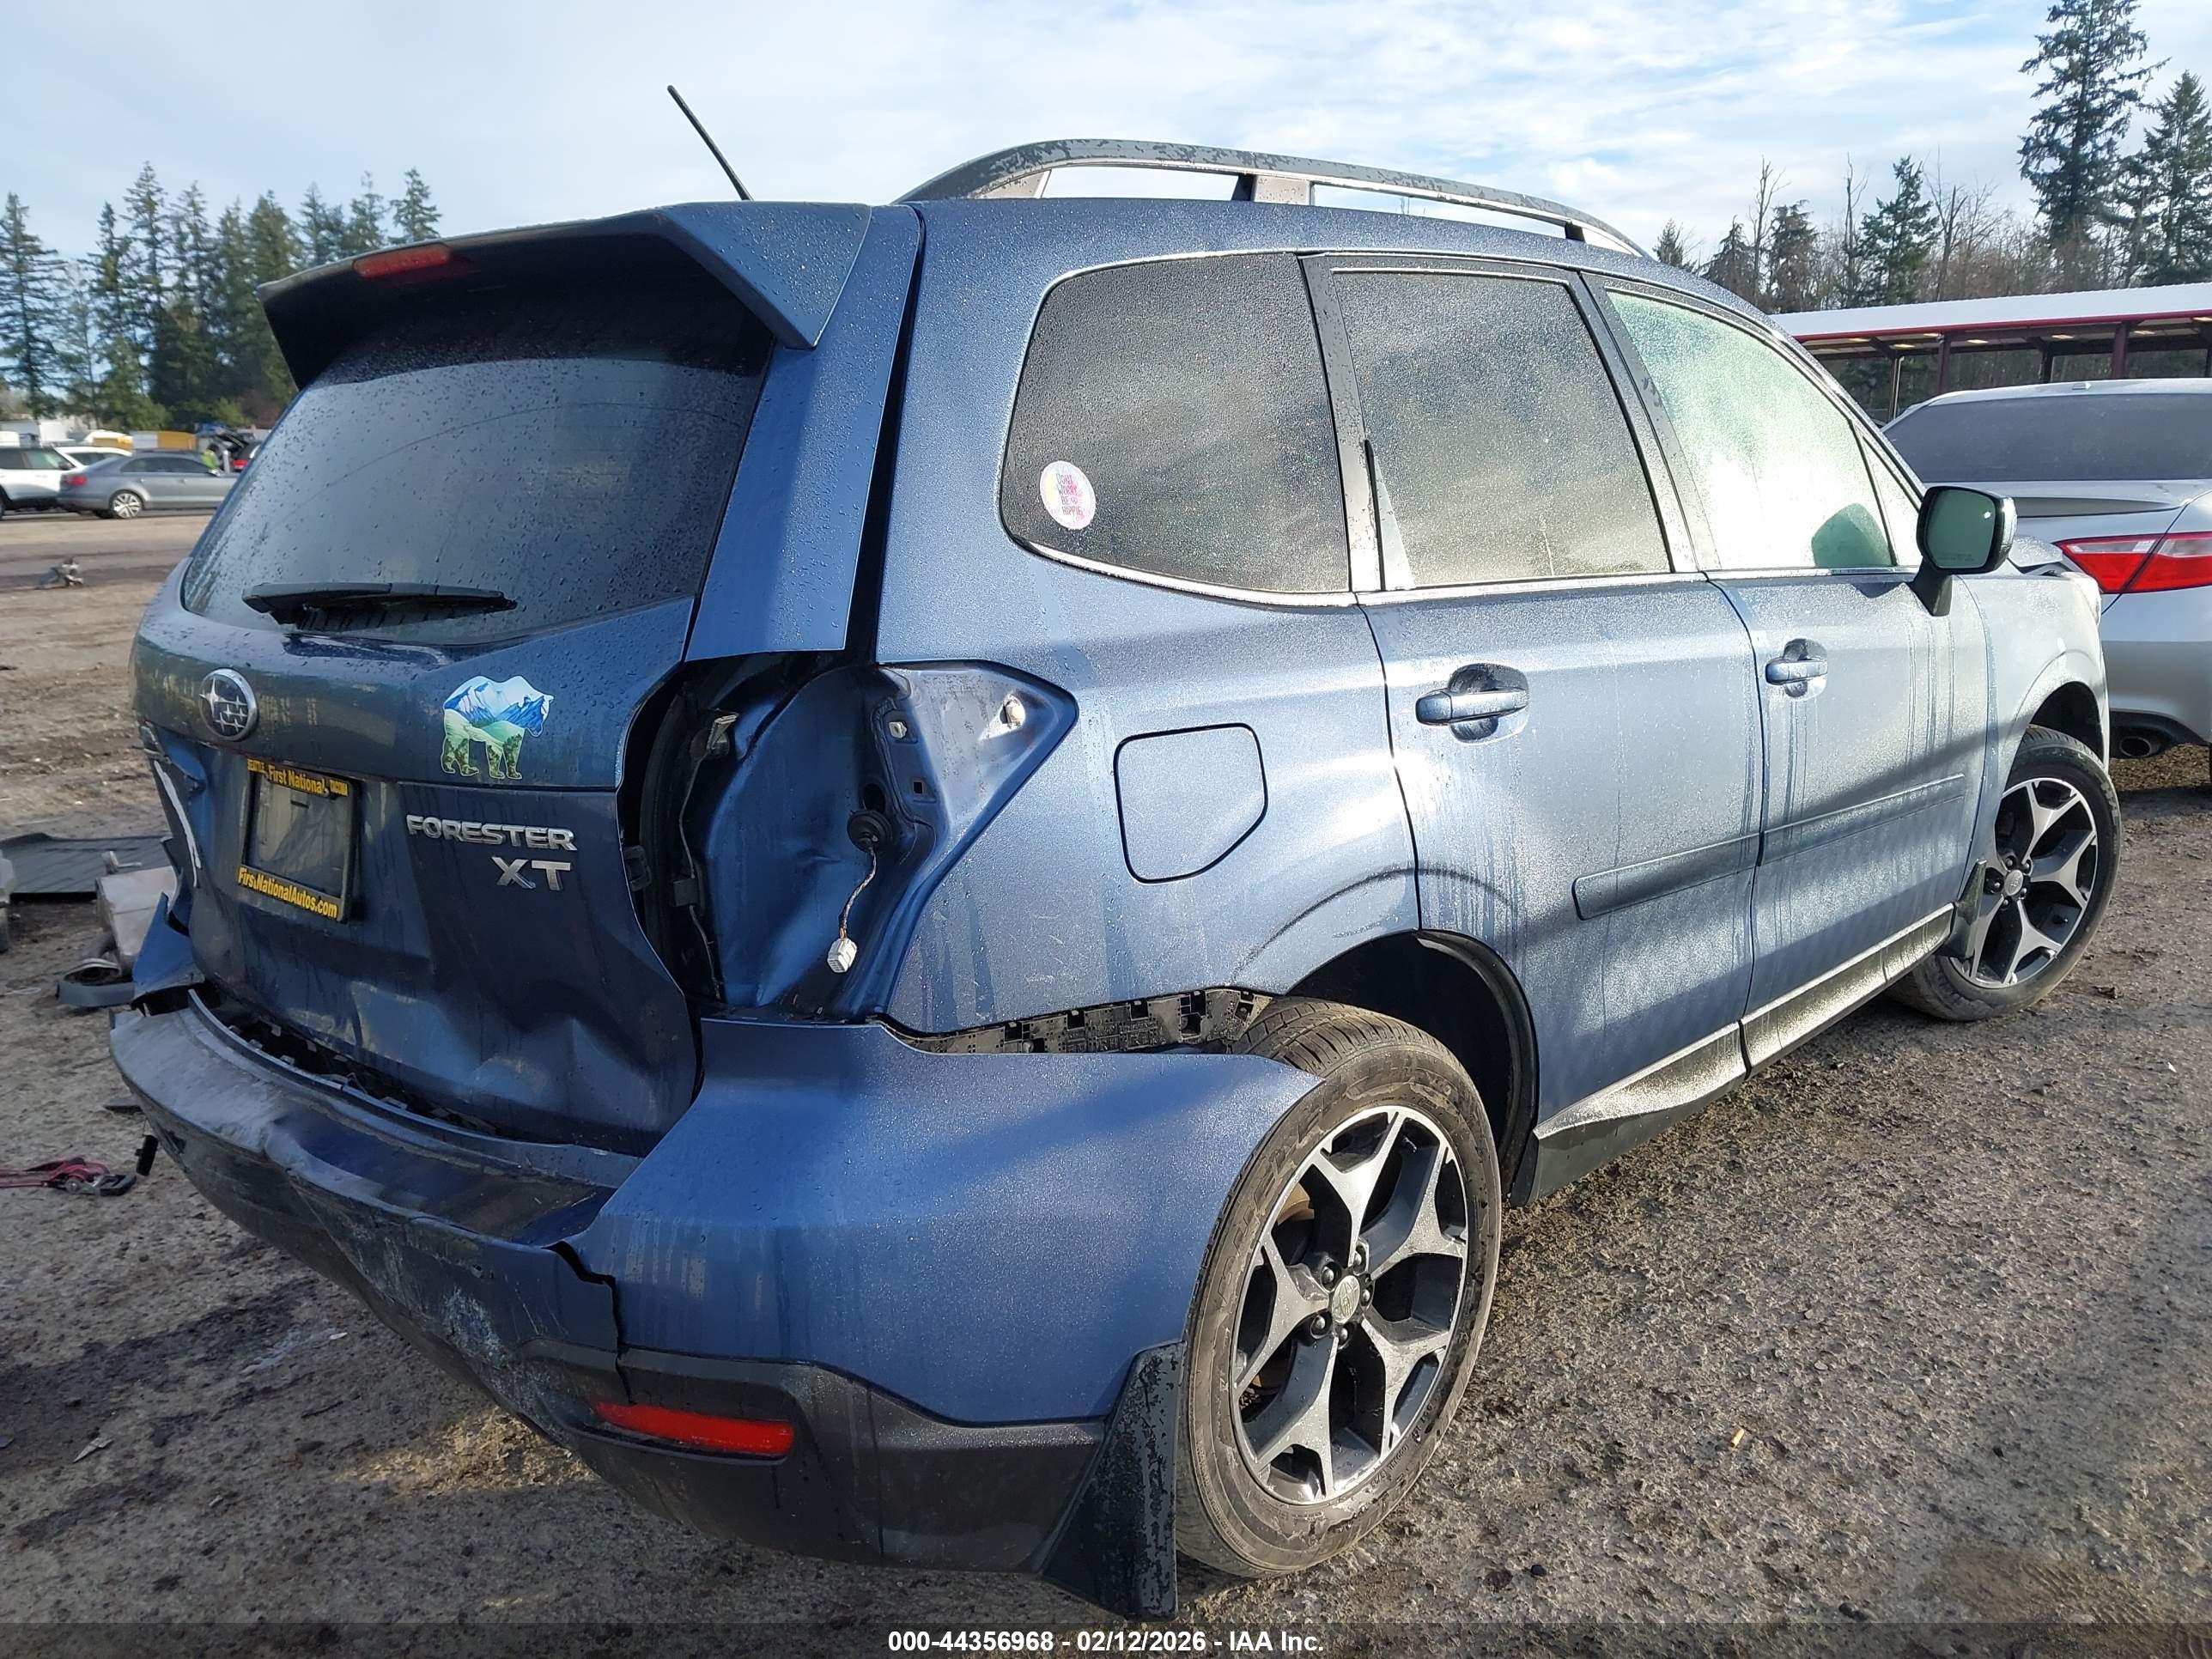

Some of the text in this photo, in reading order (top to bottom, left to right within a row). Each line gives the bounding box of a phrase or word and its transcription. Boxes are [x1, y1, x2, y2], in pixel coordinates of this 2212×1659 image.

[268, 764, 325, 794] First National
[406, 814, 578, 851] FORESTER
[491, 855, 571, 891] XT
